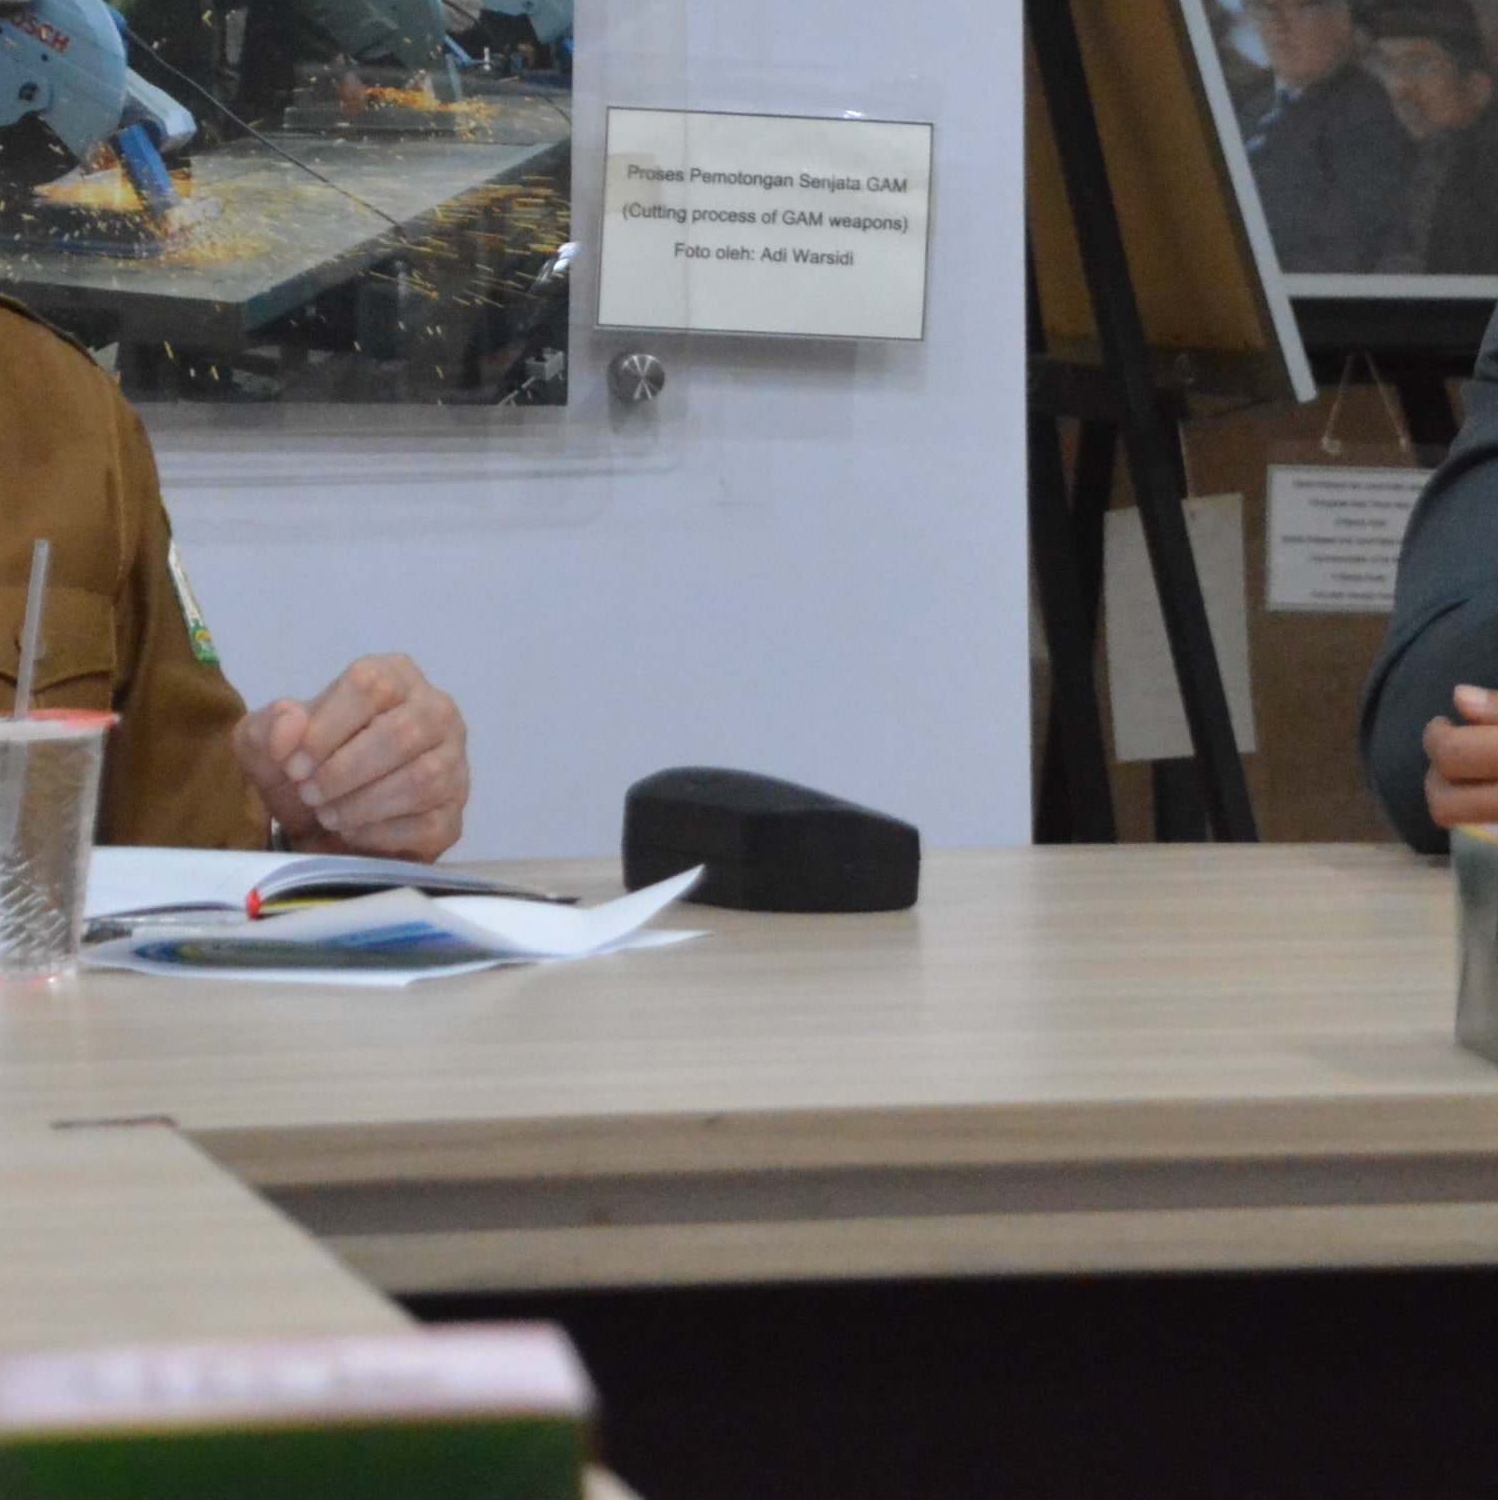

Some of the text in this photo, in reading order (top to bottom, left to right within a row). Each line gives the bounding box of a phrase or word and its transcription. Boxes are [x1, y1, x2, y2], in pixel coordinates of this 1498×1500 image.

[627, 164, 909, 194] Proses Pemotongan Senjata GAM
[621, 202, 910, 234] (Cutting process of GAM weapons)
[674, 242, 855, 266] Foto oleh: Adi Warsidi
